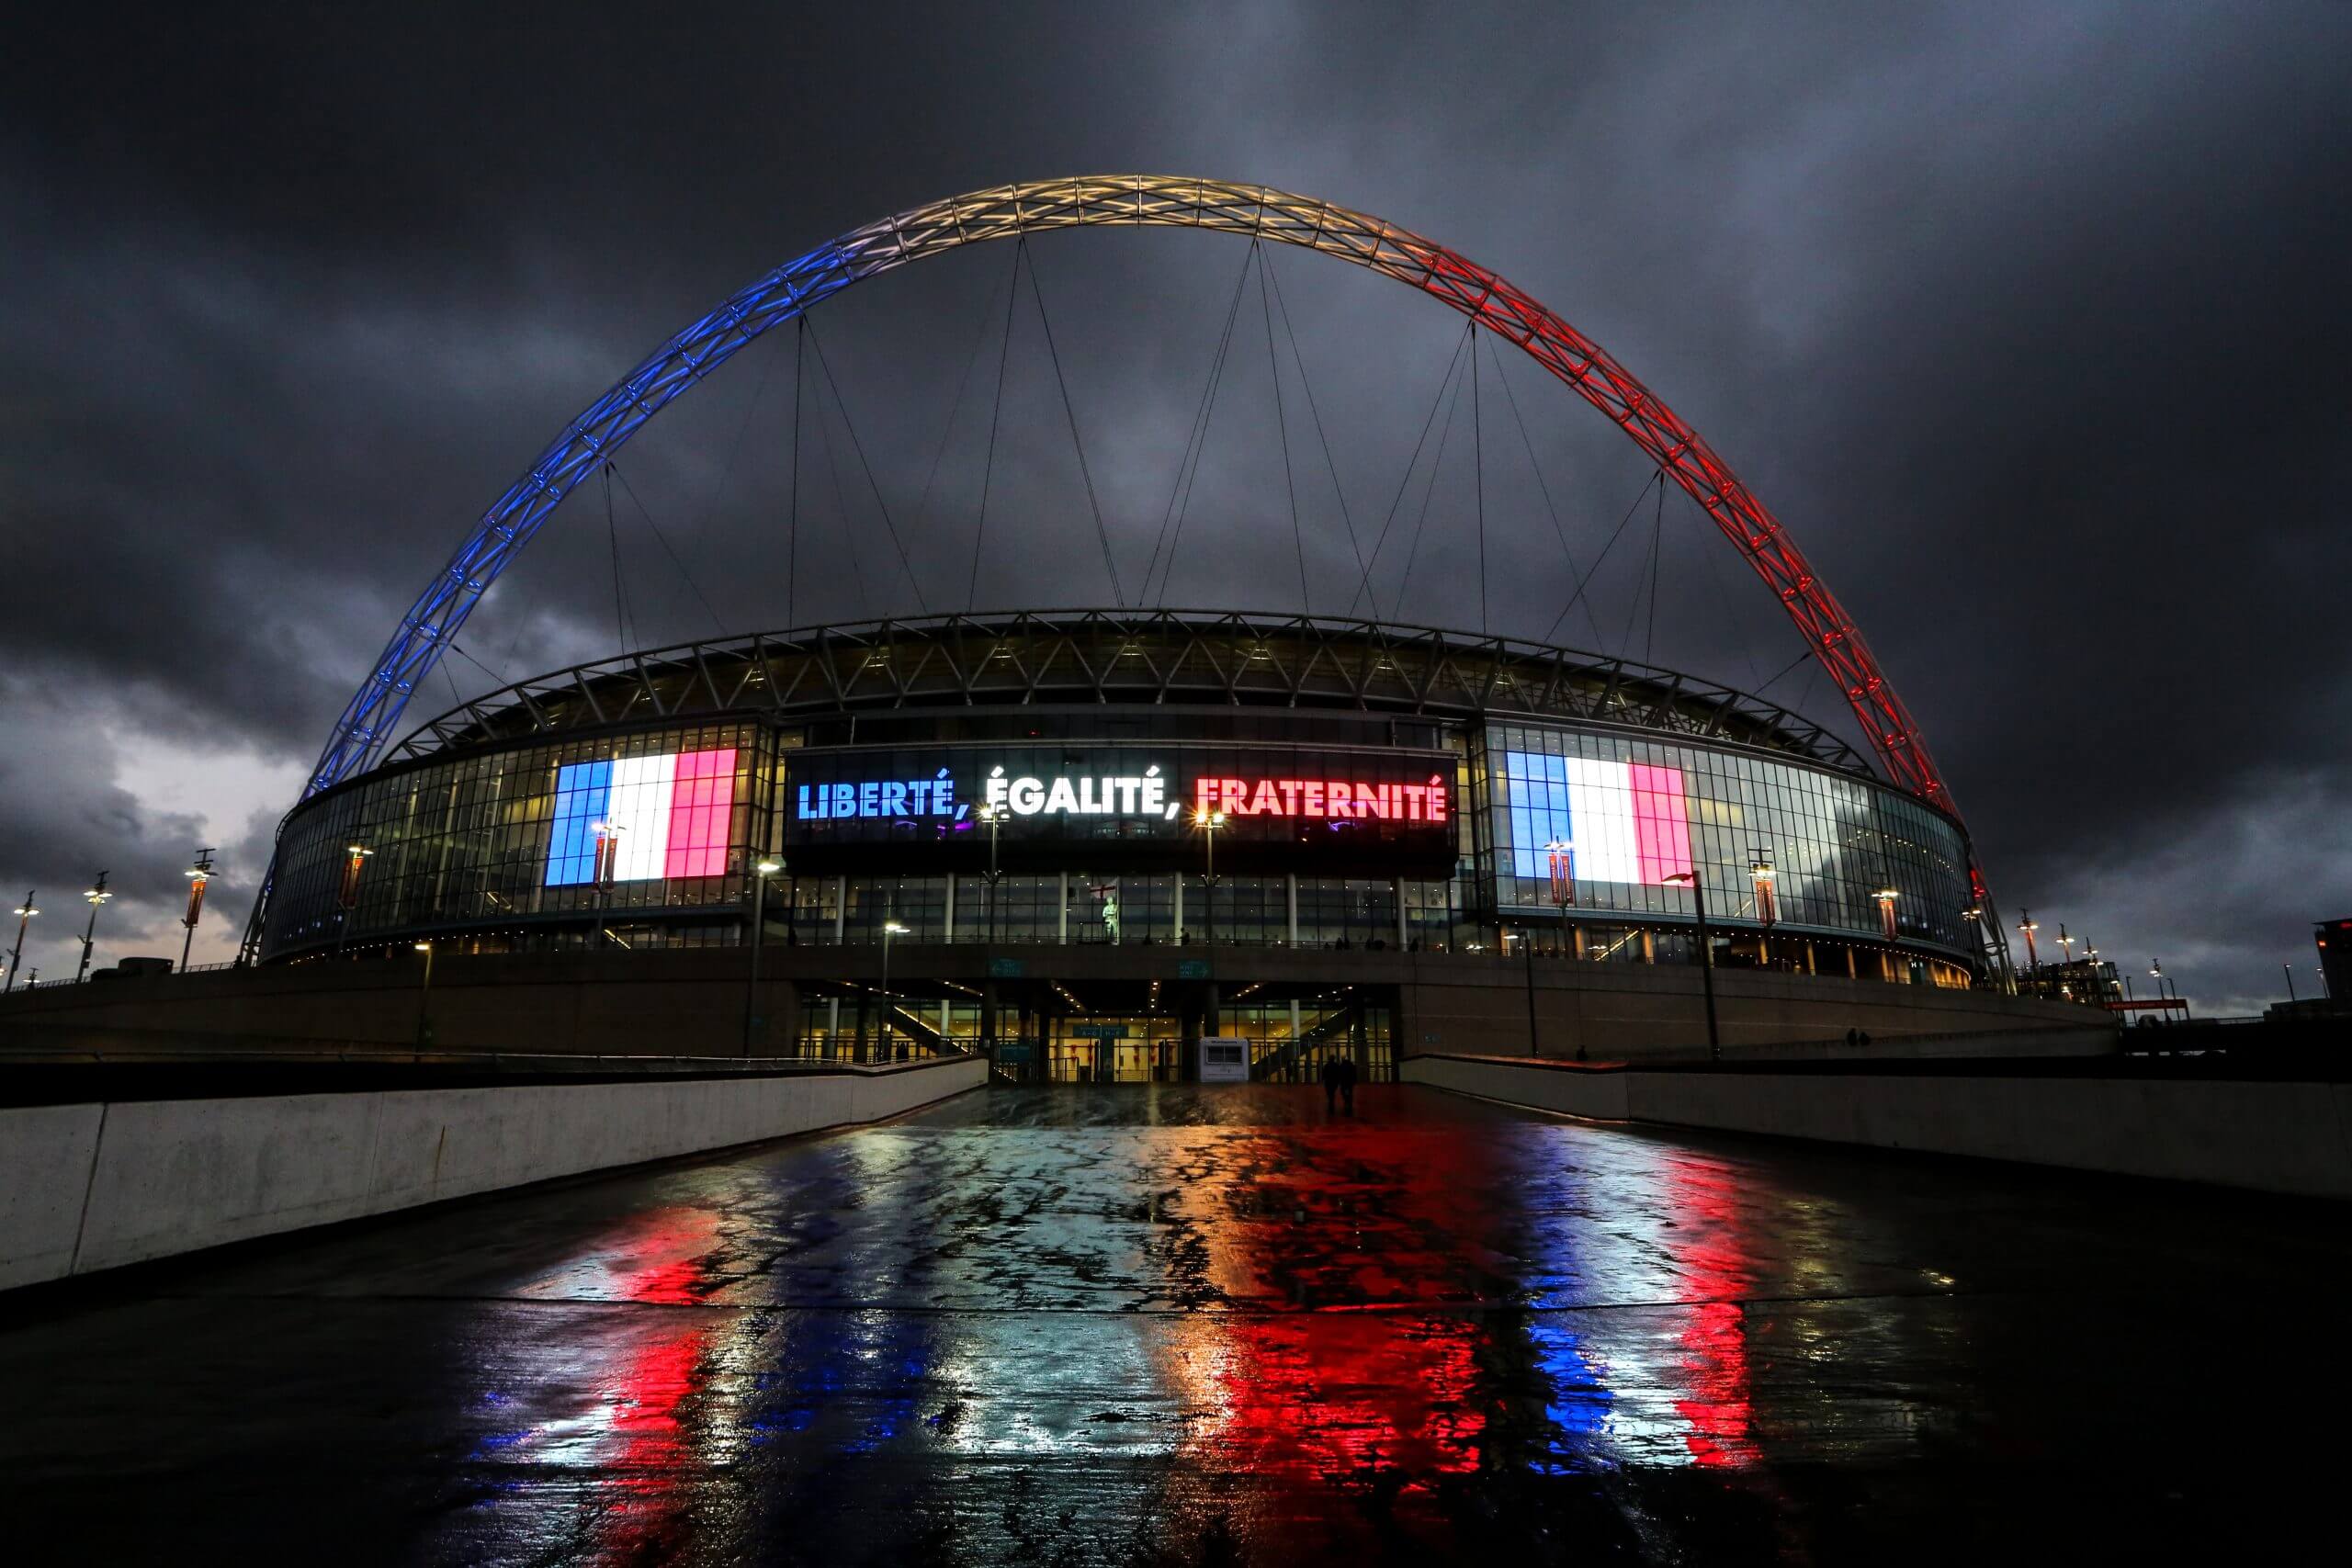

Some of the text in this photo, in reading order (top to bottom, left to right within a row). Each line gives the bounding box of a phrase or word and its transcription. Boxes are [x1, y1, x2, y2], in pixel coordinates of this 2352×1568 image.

[798, 764, 1446, 821] LIBERTÉ, ÉGALITÉ, FRATERNITÉ
